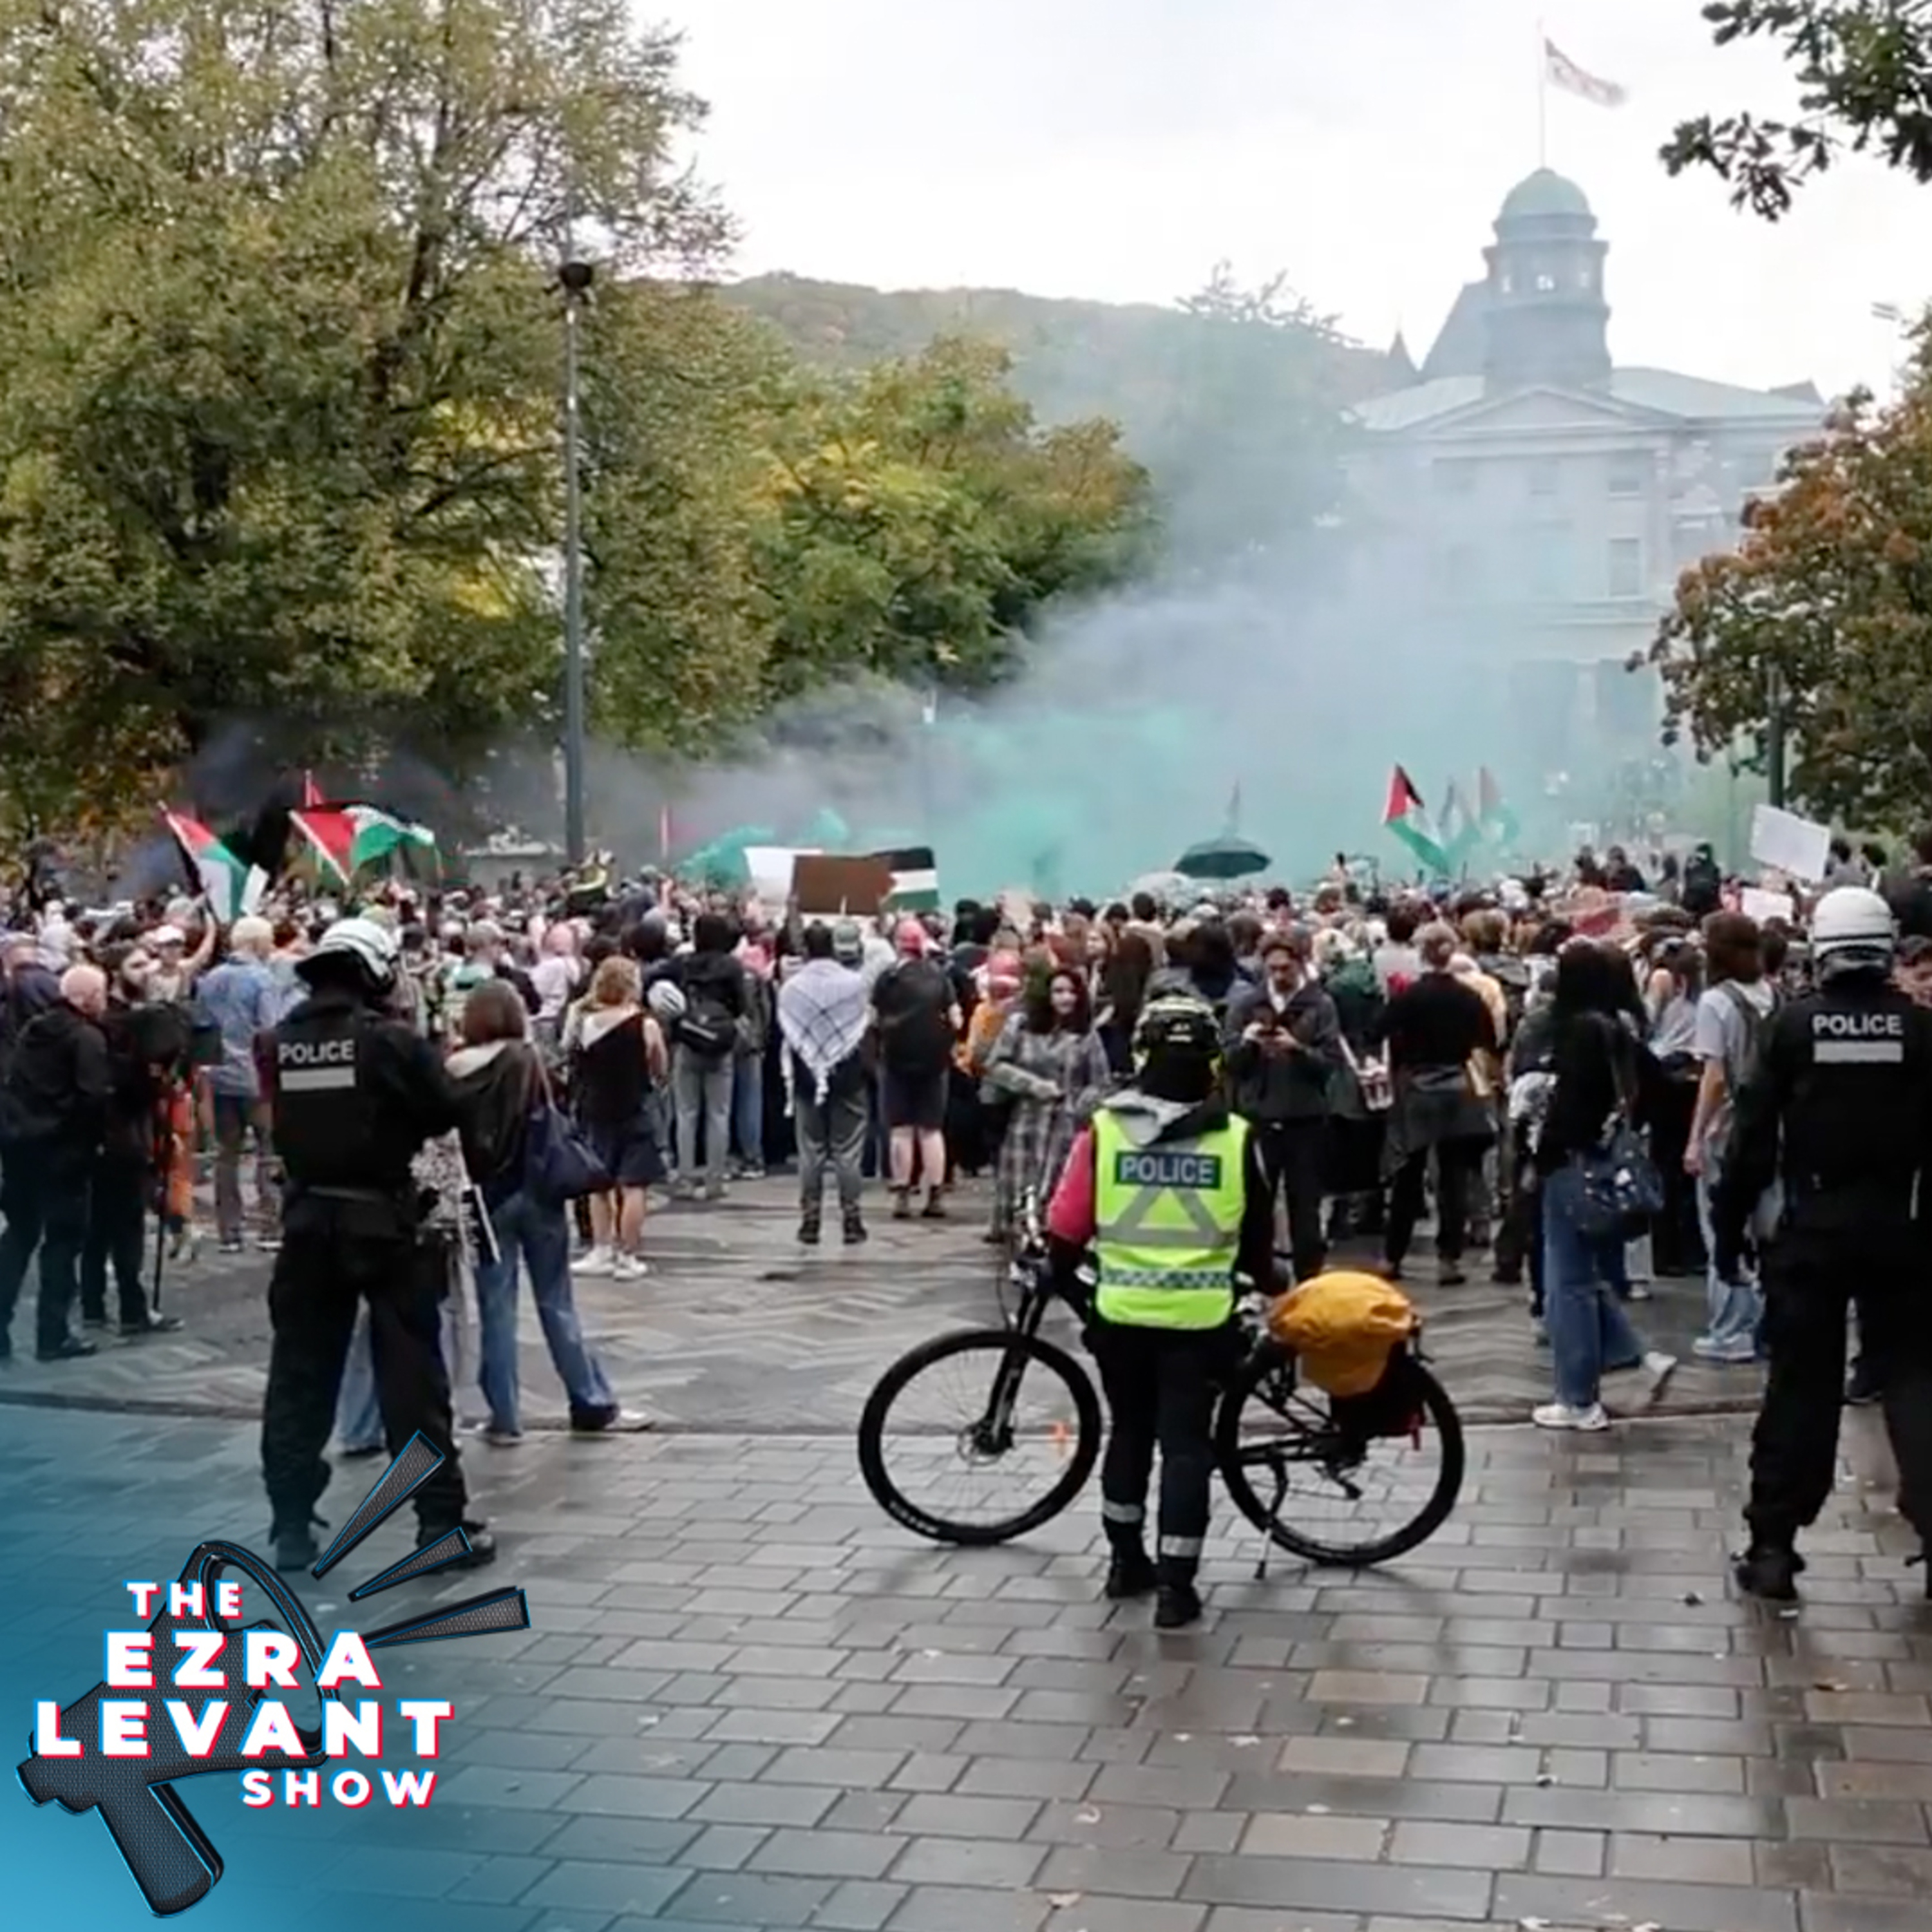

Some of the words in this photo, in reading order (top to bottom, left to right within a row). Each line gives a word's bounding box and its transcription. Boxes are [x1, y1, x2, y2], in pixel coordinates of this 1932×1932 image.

[1812, 1013, 1904, 1036] POLICE
[278, 1039, 355, 1064] POLICE
[1121, 1155, 1215, 1184] POLICE
